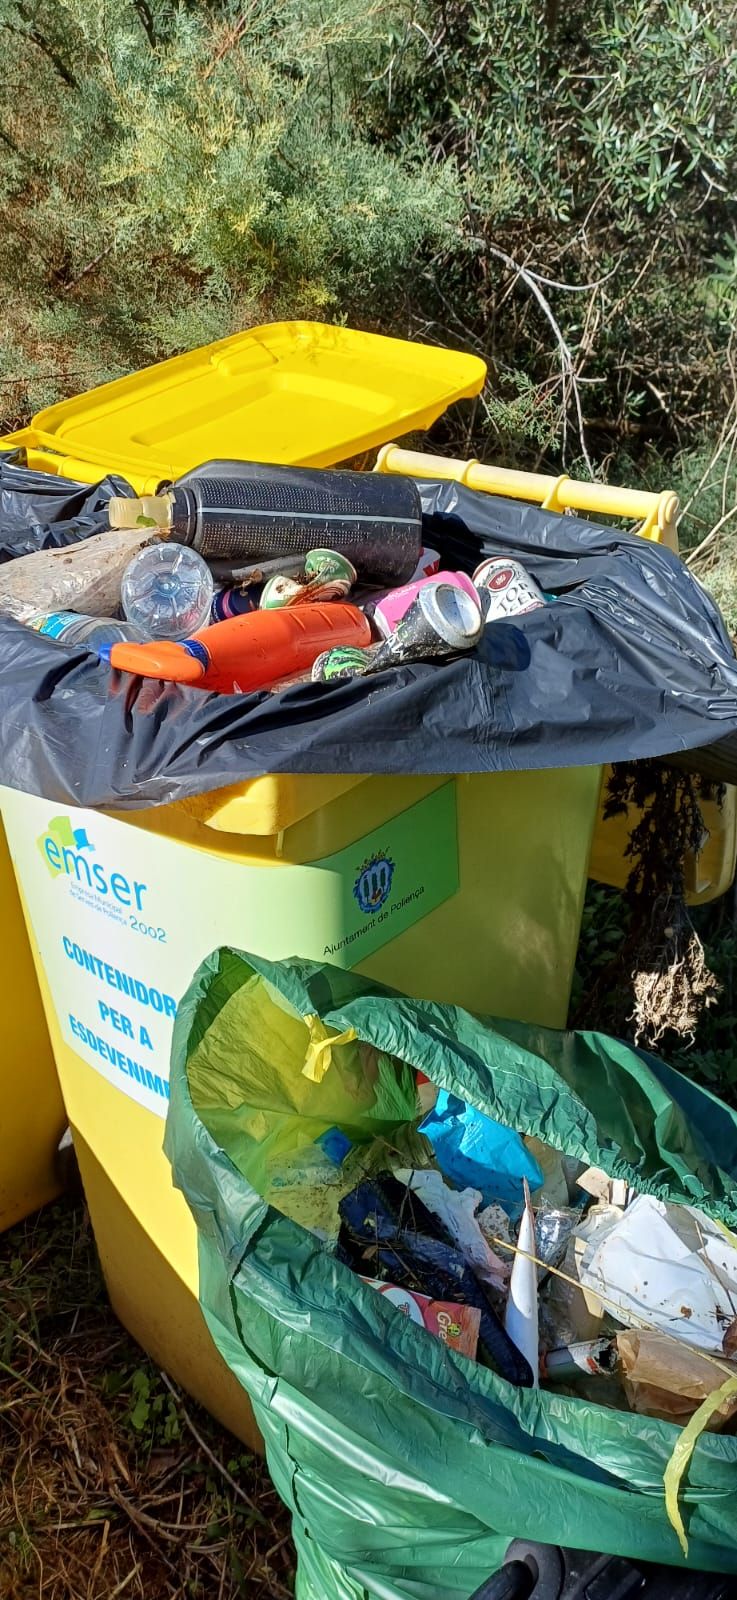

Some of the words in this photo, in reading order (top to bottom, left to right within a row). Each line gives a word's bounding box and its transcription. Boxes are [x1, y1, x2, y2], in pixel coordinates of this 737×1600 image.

[44, 837, 148, 911] emser
[129, 915, 168, 944] 2002
[323, 918, 376, 956] Ajuntament
[377, 910, 389, 923] de
[62, 935, 177, 1018] CONTENIDOR
[98, 1000, 135, 1040] PER
[139, 1025, 154, 1051] A
[437, 1311, 452, 1342] Gre
